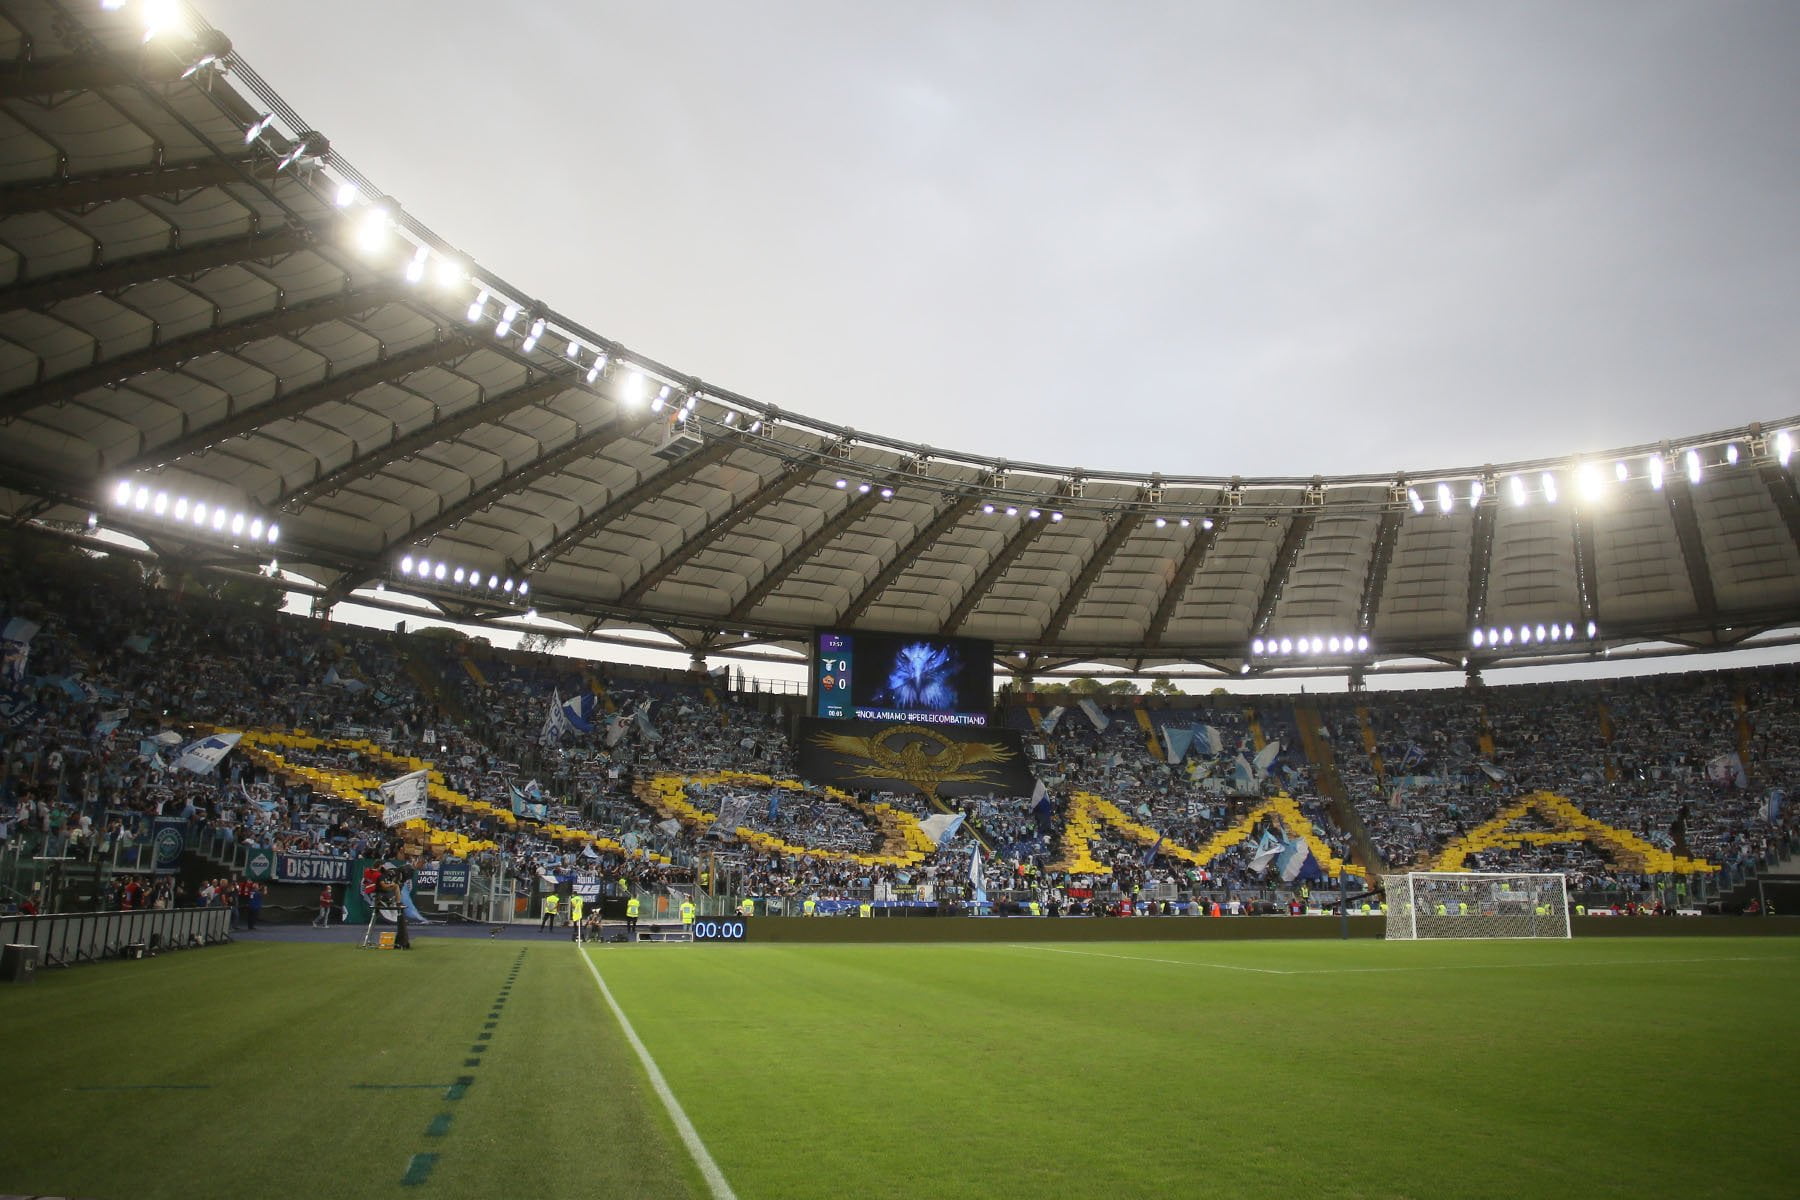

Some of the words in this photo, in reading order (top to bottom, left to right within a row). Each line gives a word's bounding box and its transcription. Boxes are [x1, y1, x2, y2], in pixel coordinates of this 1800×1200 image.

[839, 660, 846, 672] 0
[838, 678, 846, 690] 0
[908, 712, 985, 725] #PERLEICOMBATTIAMO
[287, 858, 347, 879] DISTINTI
[695, 922, 743, 938] 00:00
